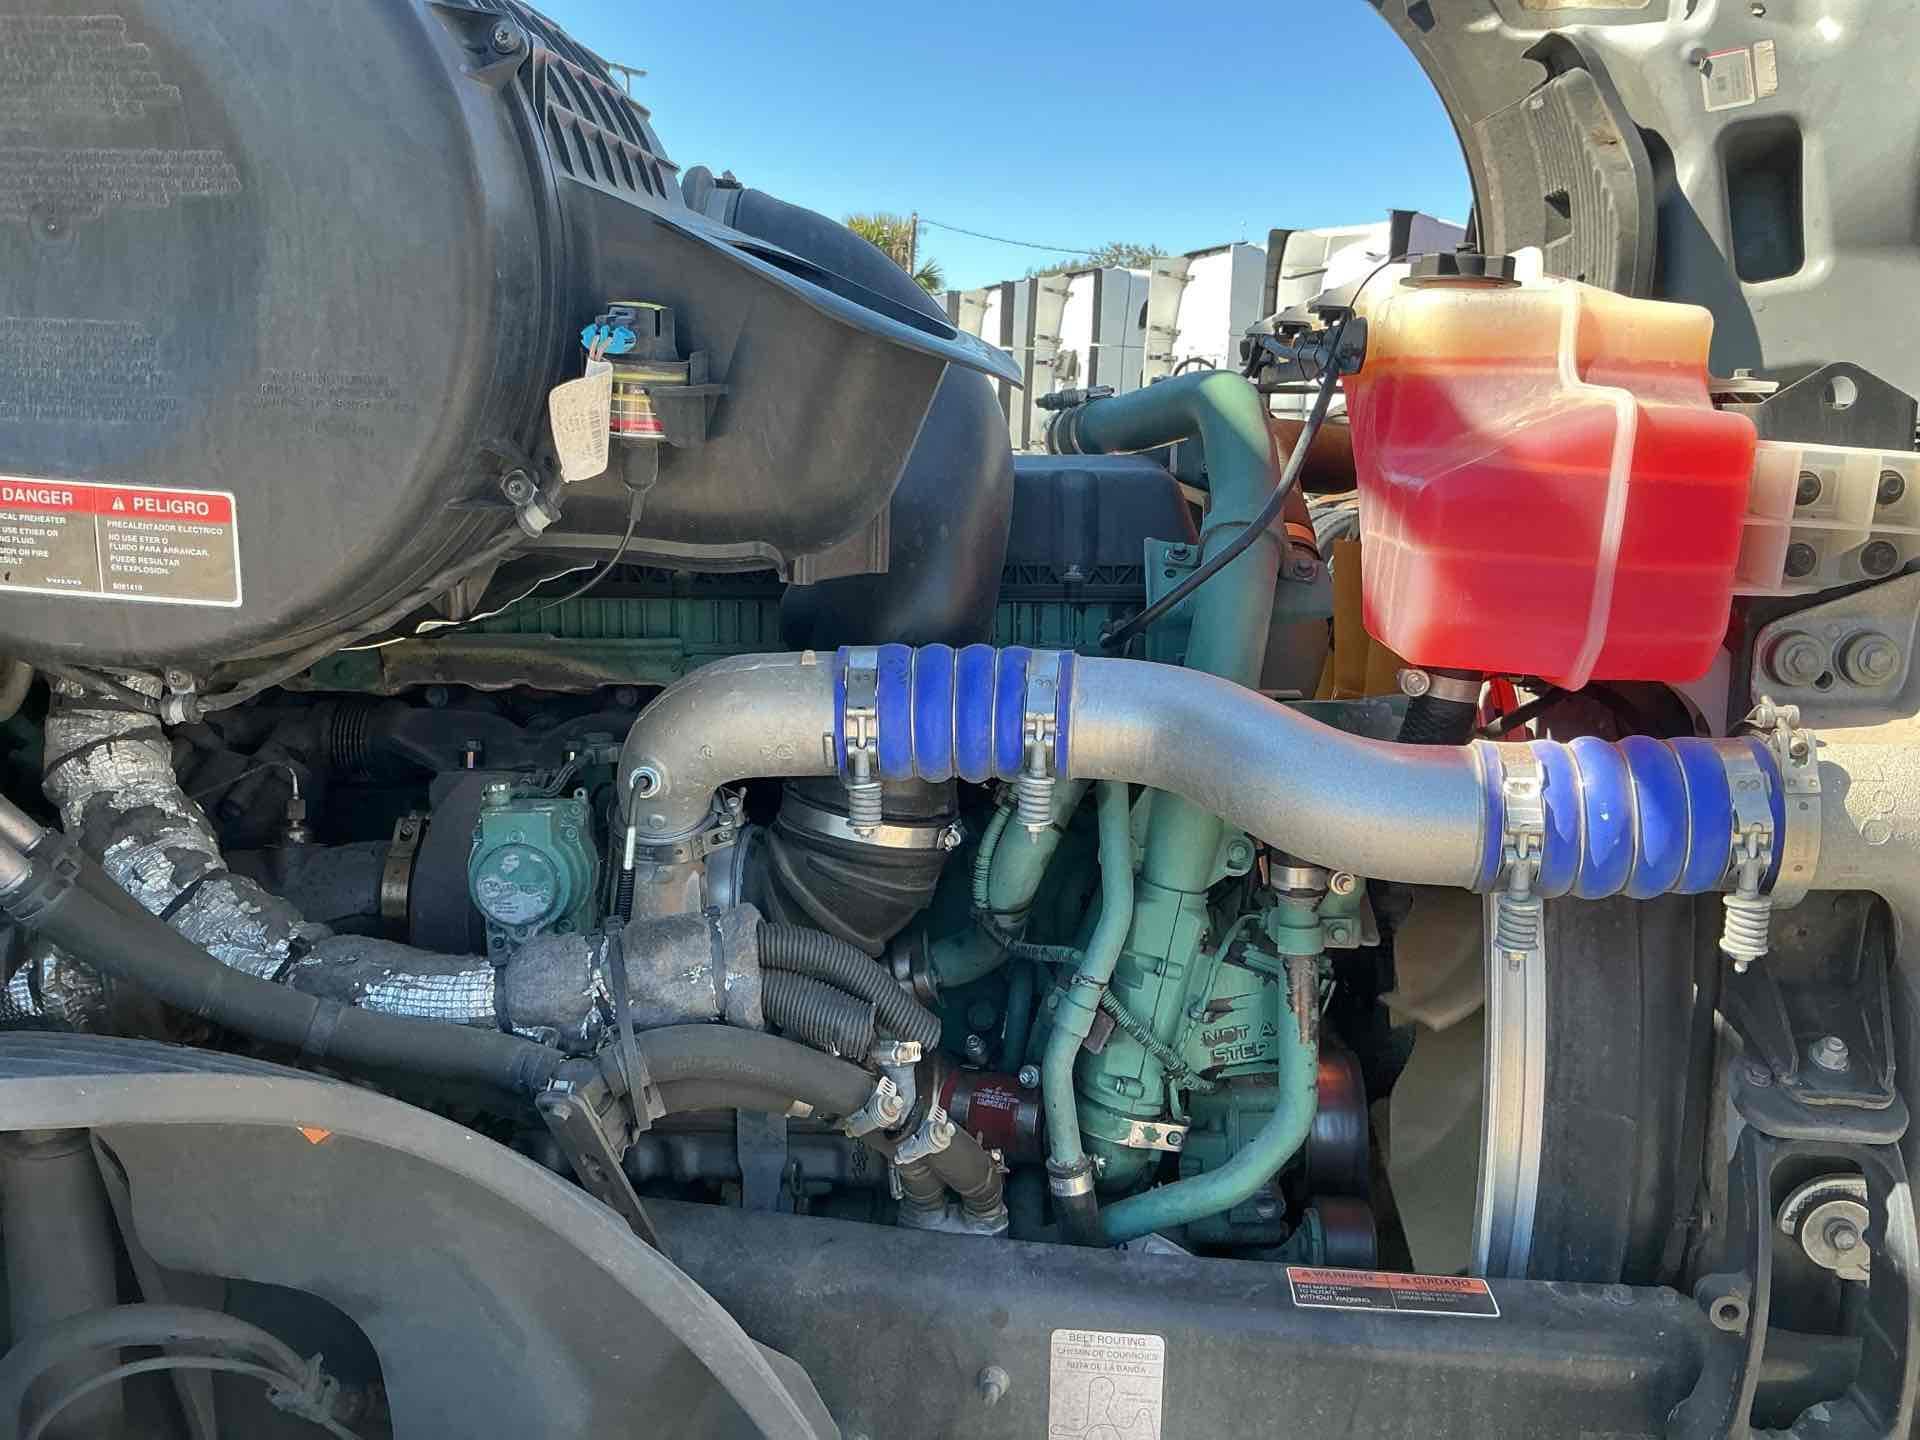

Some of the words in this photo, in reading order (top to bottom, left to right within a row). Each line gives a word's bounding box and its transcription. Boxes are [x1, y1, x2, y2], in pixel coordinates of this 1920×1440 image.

[2, 487, 73, 505] DANGER
[133, 497, 209, 515] PELIGRO
[107, 519, 176, 532] PRECALENTADOR
[46, 529, 58, 537] OR
[108, 533, 120, 541] NO
[122, 534, 138, 543] USE
[139, 535, 161, 544] ETER
[109, 542, 138, 552] FLUIDO
[139, 544, 161, 553] PARA
[110, 554, 137, 563] PUEDE
[138, 556, 180, 566] RESULTAR
[111, 564, 122, 572] EN
[1202, 1024, 1249, 1041] NOT
[1260, 1020, 1277, 1037] A
[1212, 1040, 1270, 1063] STEP
[1299, 1293, 1332, 1301] WITHOUT
[1068, 1333, 1095, 1345] BELT
[1097, 1335, 1146, 1347] ROUTING
